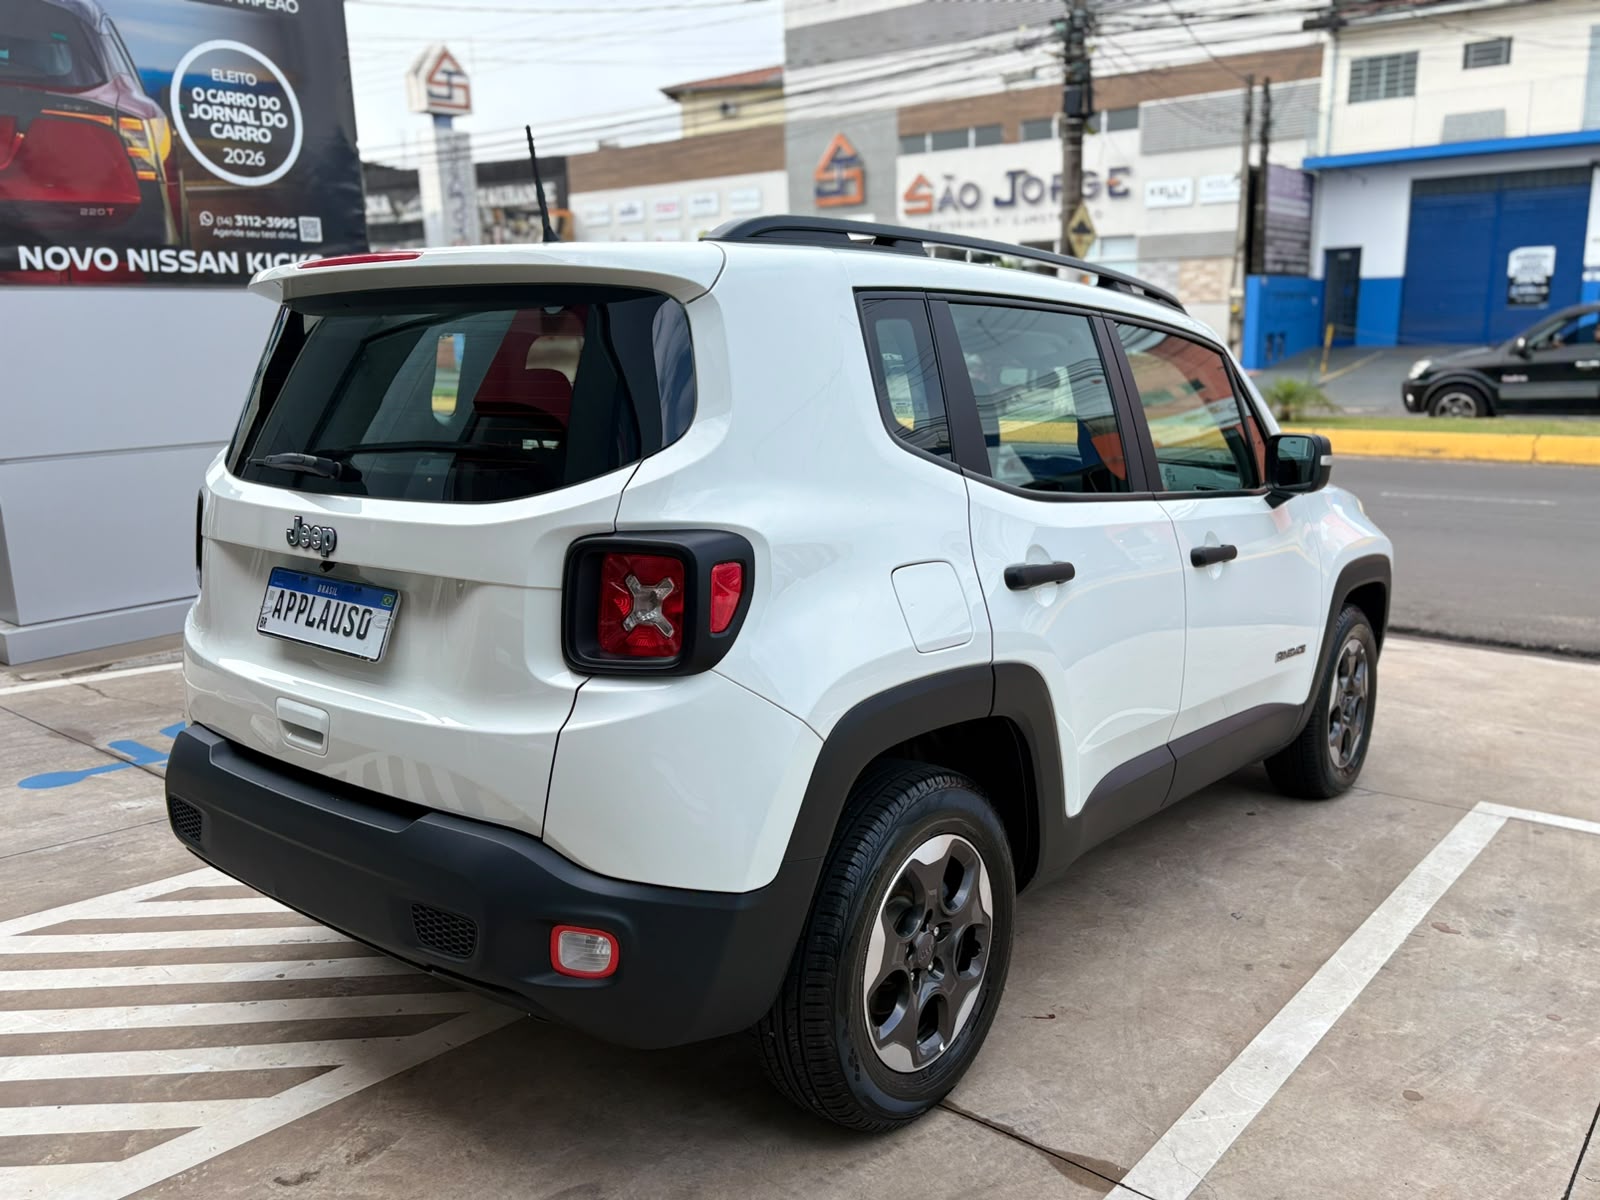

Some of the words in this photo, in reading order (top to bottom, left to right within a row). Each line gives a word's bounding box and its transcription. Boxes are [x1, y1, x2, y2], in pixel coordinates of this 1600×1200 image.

[211, 68, 257, 86] ELEITO
[192, 87, 205, 102] O
[206, 89, 257, 108] CARRO
[259, 95, 281, 111] DO
[189, 103, 260, 126] JORNAL
[261, 111, 288, 128] DO
[210, 122, 272, 143] CARRO
[223, 147, 266, 167] 2026
[234, 215, 297, 229] 3112-3995
[18, 245, 119, 272] NOVO
[126, 248, 239, 275] NISSAN
[245, 252, 323, 275] KIC
[286, 515, 338, 558] Jeep
[317, 584, 338, 596] BRASIL
[271, 589, 373, 640] APPLAUSO
